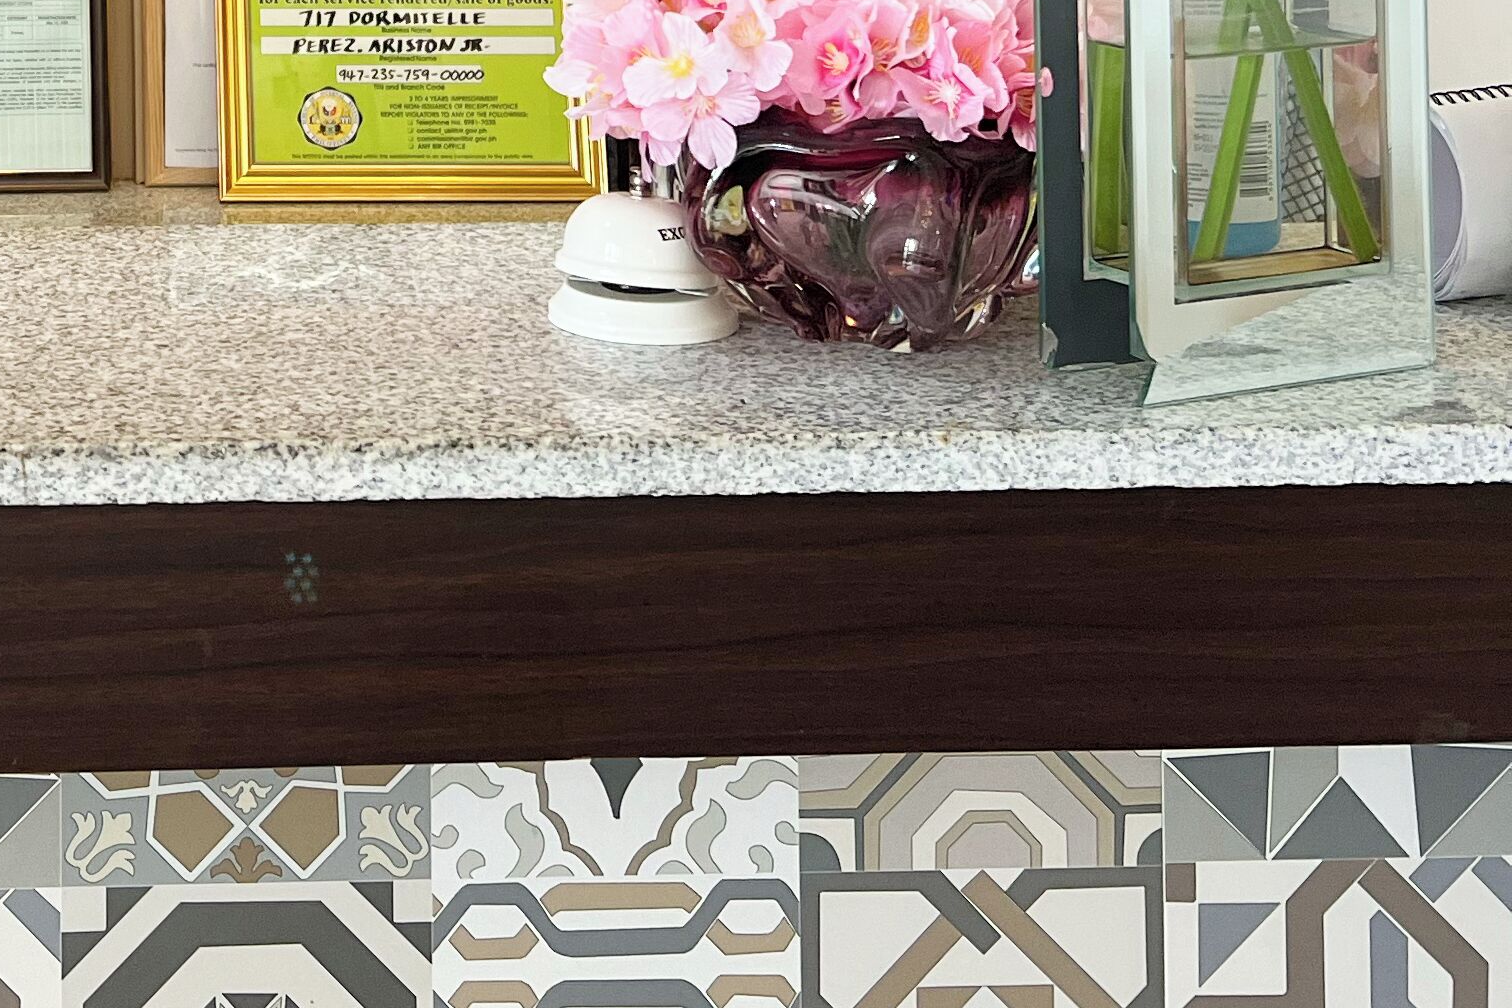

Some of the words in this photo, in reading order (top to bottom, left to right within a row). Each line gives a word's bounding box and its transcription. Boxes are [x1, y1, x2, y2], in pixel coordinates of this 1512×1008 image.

[300, 10, 336, 26] 717
[348, 10, 486, 26] DORMITELLE
[368, 38, 456, 54] ARISTON
[338, 69, 485, 82] 947-235-759-00000
